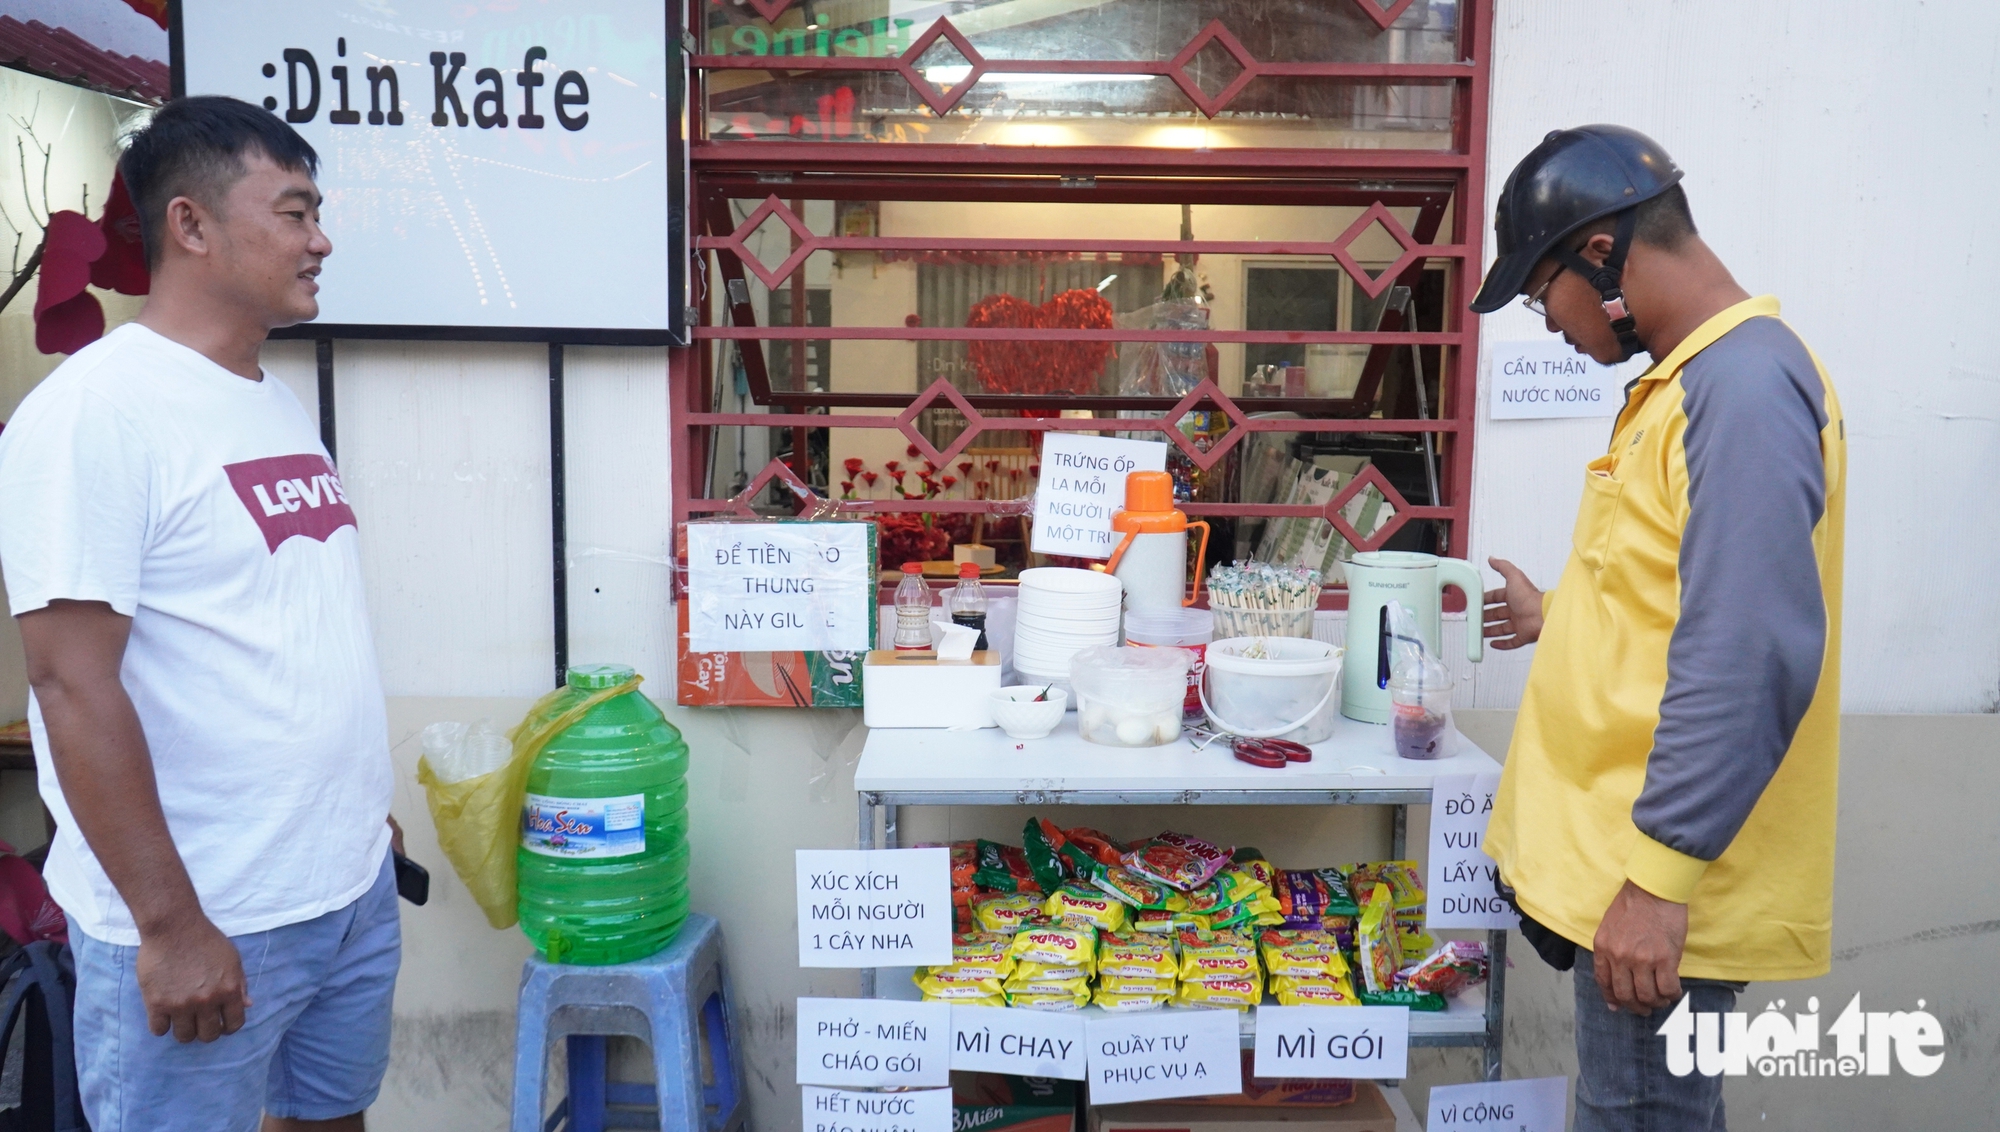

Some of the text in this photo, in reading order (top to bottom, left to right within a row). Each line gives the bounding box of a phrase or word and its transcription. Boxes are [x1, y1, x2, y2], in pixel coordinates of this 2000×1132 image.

[429, 46, 590, 131] Kafe
[1503, 355, 1587, 377] CẨN THẬN
[1502, 386, 1601, 403] NƯỚC NÓNG
[1054, 451, 1109, 471] TRỨNG
[1051, 476, 1106, 495] LA MỖI
[1049, 502, 1102, 520] NGƯỜI
[1047, 524, 1084, 543] MỘT
[715, 541, 742, 566] ĐỂ
[747, 541, 791, 565] TIỀN
[1368, 581, 1408, 589] SUNHOUSE
[725, 609, 765, 630] NÀY
[1445, 793, 1475, 815] ĐỒ
[555, 810, 593, 835] Sen
[1444, 831, 1478, 849] VUI
[810, 870, 898, 891] XÚC XÍCH
[1443, 859, 1478, 882] LẤY
[812, 898, 924, 920] MỖI NGƯỜI
[1442, 893, 1502, 914] DÙNG
[813, 930, 914, 950] 1 CÂY NHA
[817, 1017, 860, 1038] PHỞ
[877, 1020, 927, 1041] MIẾN
[956, 1026, 1073, 1060] MÌ CHAY
[1102, 1033, 1189, 1057] QUẦY TỰ
[1277, 1027, 1383, 1060] MÌ GÓI
[822, 1050, 922, 1072] CHÁO GÓI
[1104, 1061, 1207, 1084] PHỤC VỤ Ạ
[816, 1091, 915, 1115] HẾT NƯỚC
[1441, 1101, 1514, 1124] VÌ CỘNG
